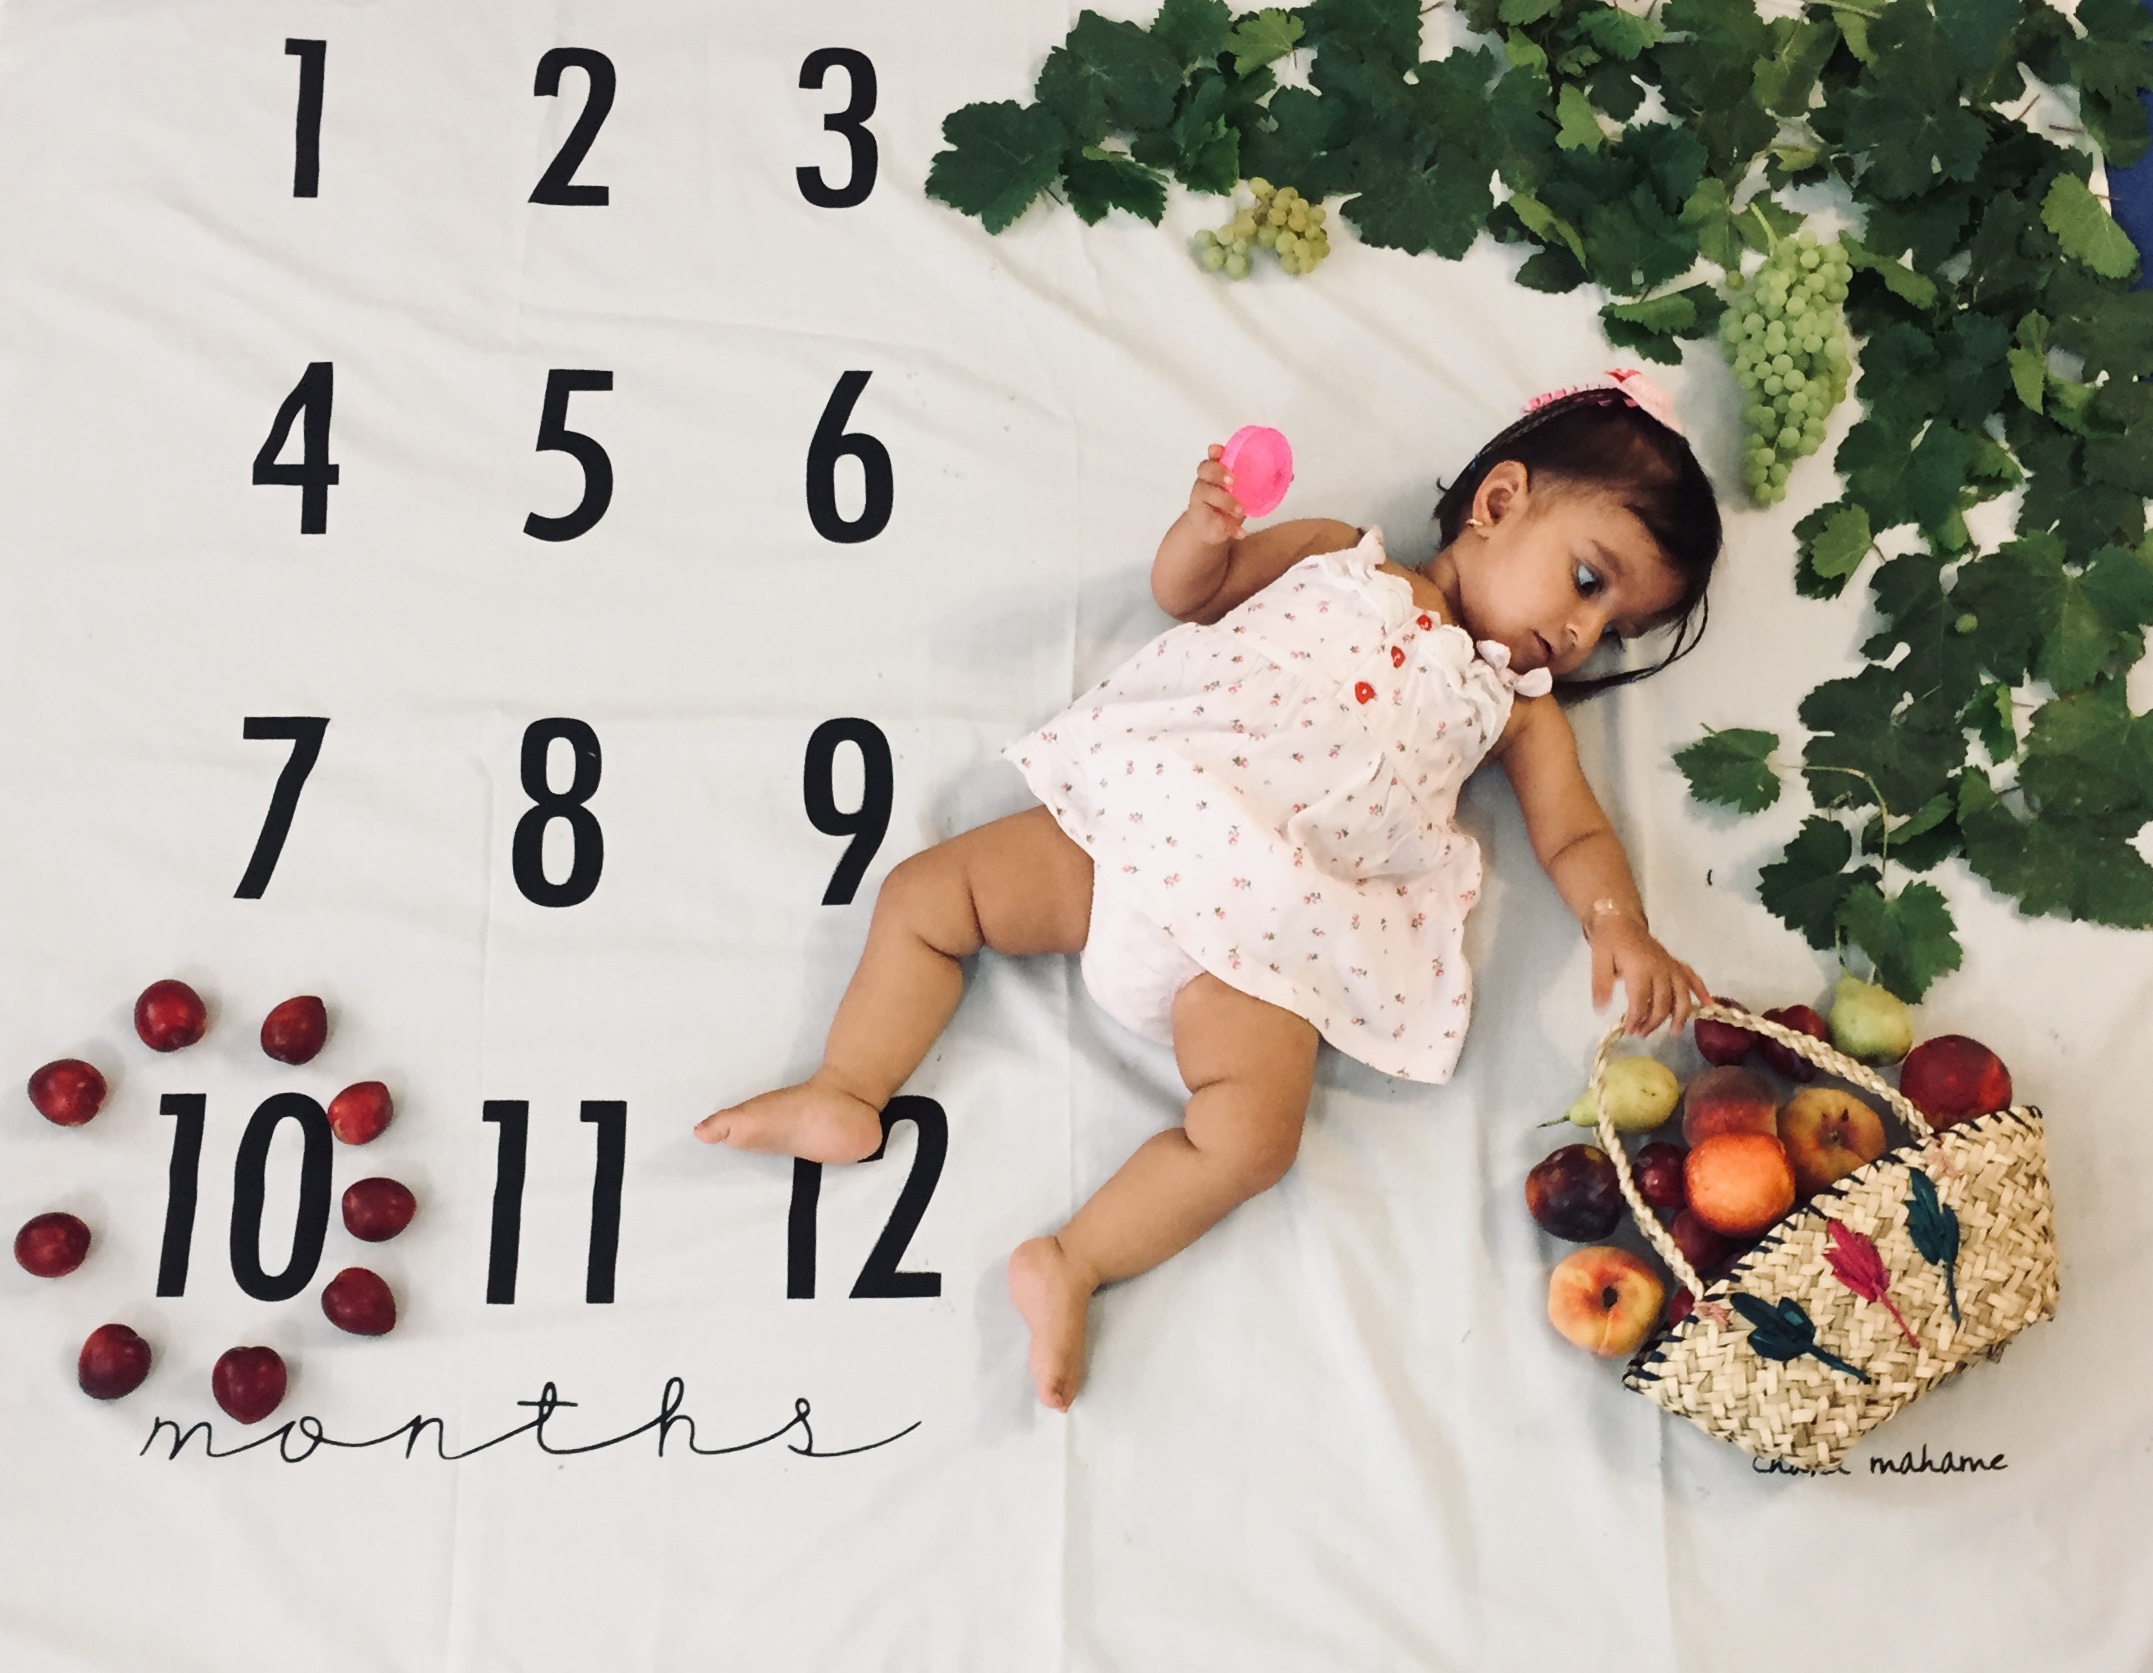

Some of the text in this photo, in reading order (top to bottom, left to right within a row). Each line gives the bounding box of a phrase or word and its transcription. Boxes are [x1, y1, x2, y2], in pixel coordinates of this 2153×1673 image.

[285, 38, 327, 198] 1
[528, 47, 617, 207] 2
[796, 47, 879, 209] 3
[252, 361, 339, 535] 4
[523, 369, 614, 541] 5
[807, 371, 894, 544] 6
[234, 717, 331, 900] 7
[512, 717, 603, 908] 8
[804, 717, 893, 905] 9
[157, 1092, 334, 1303] 10
[482, 1100, 628, 1305] 11
[787, 1095, 949, 1300] 12
[140, 1377, 921, 1464] months
[1869, 1443, 2009, 1475] mahame
